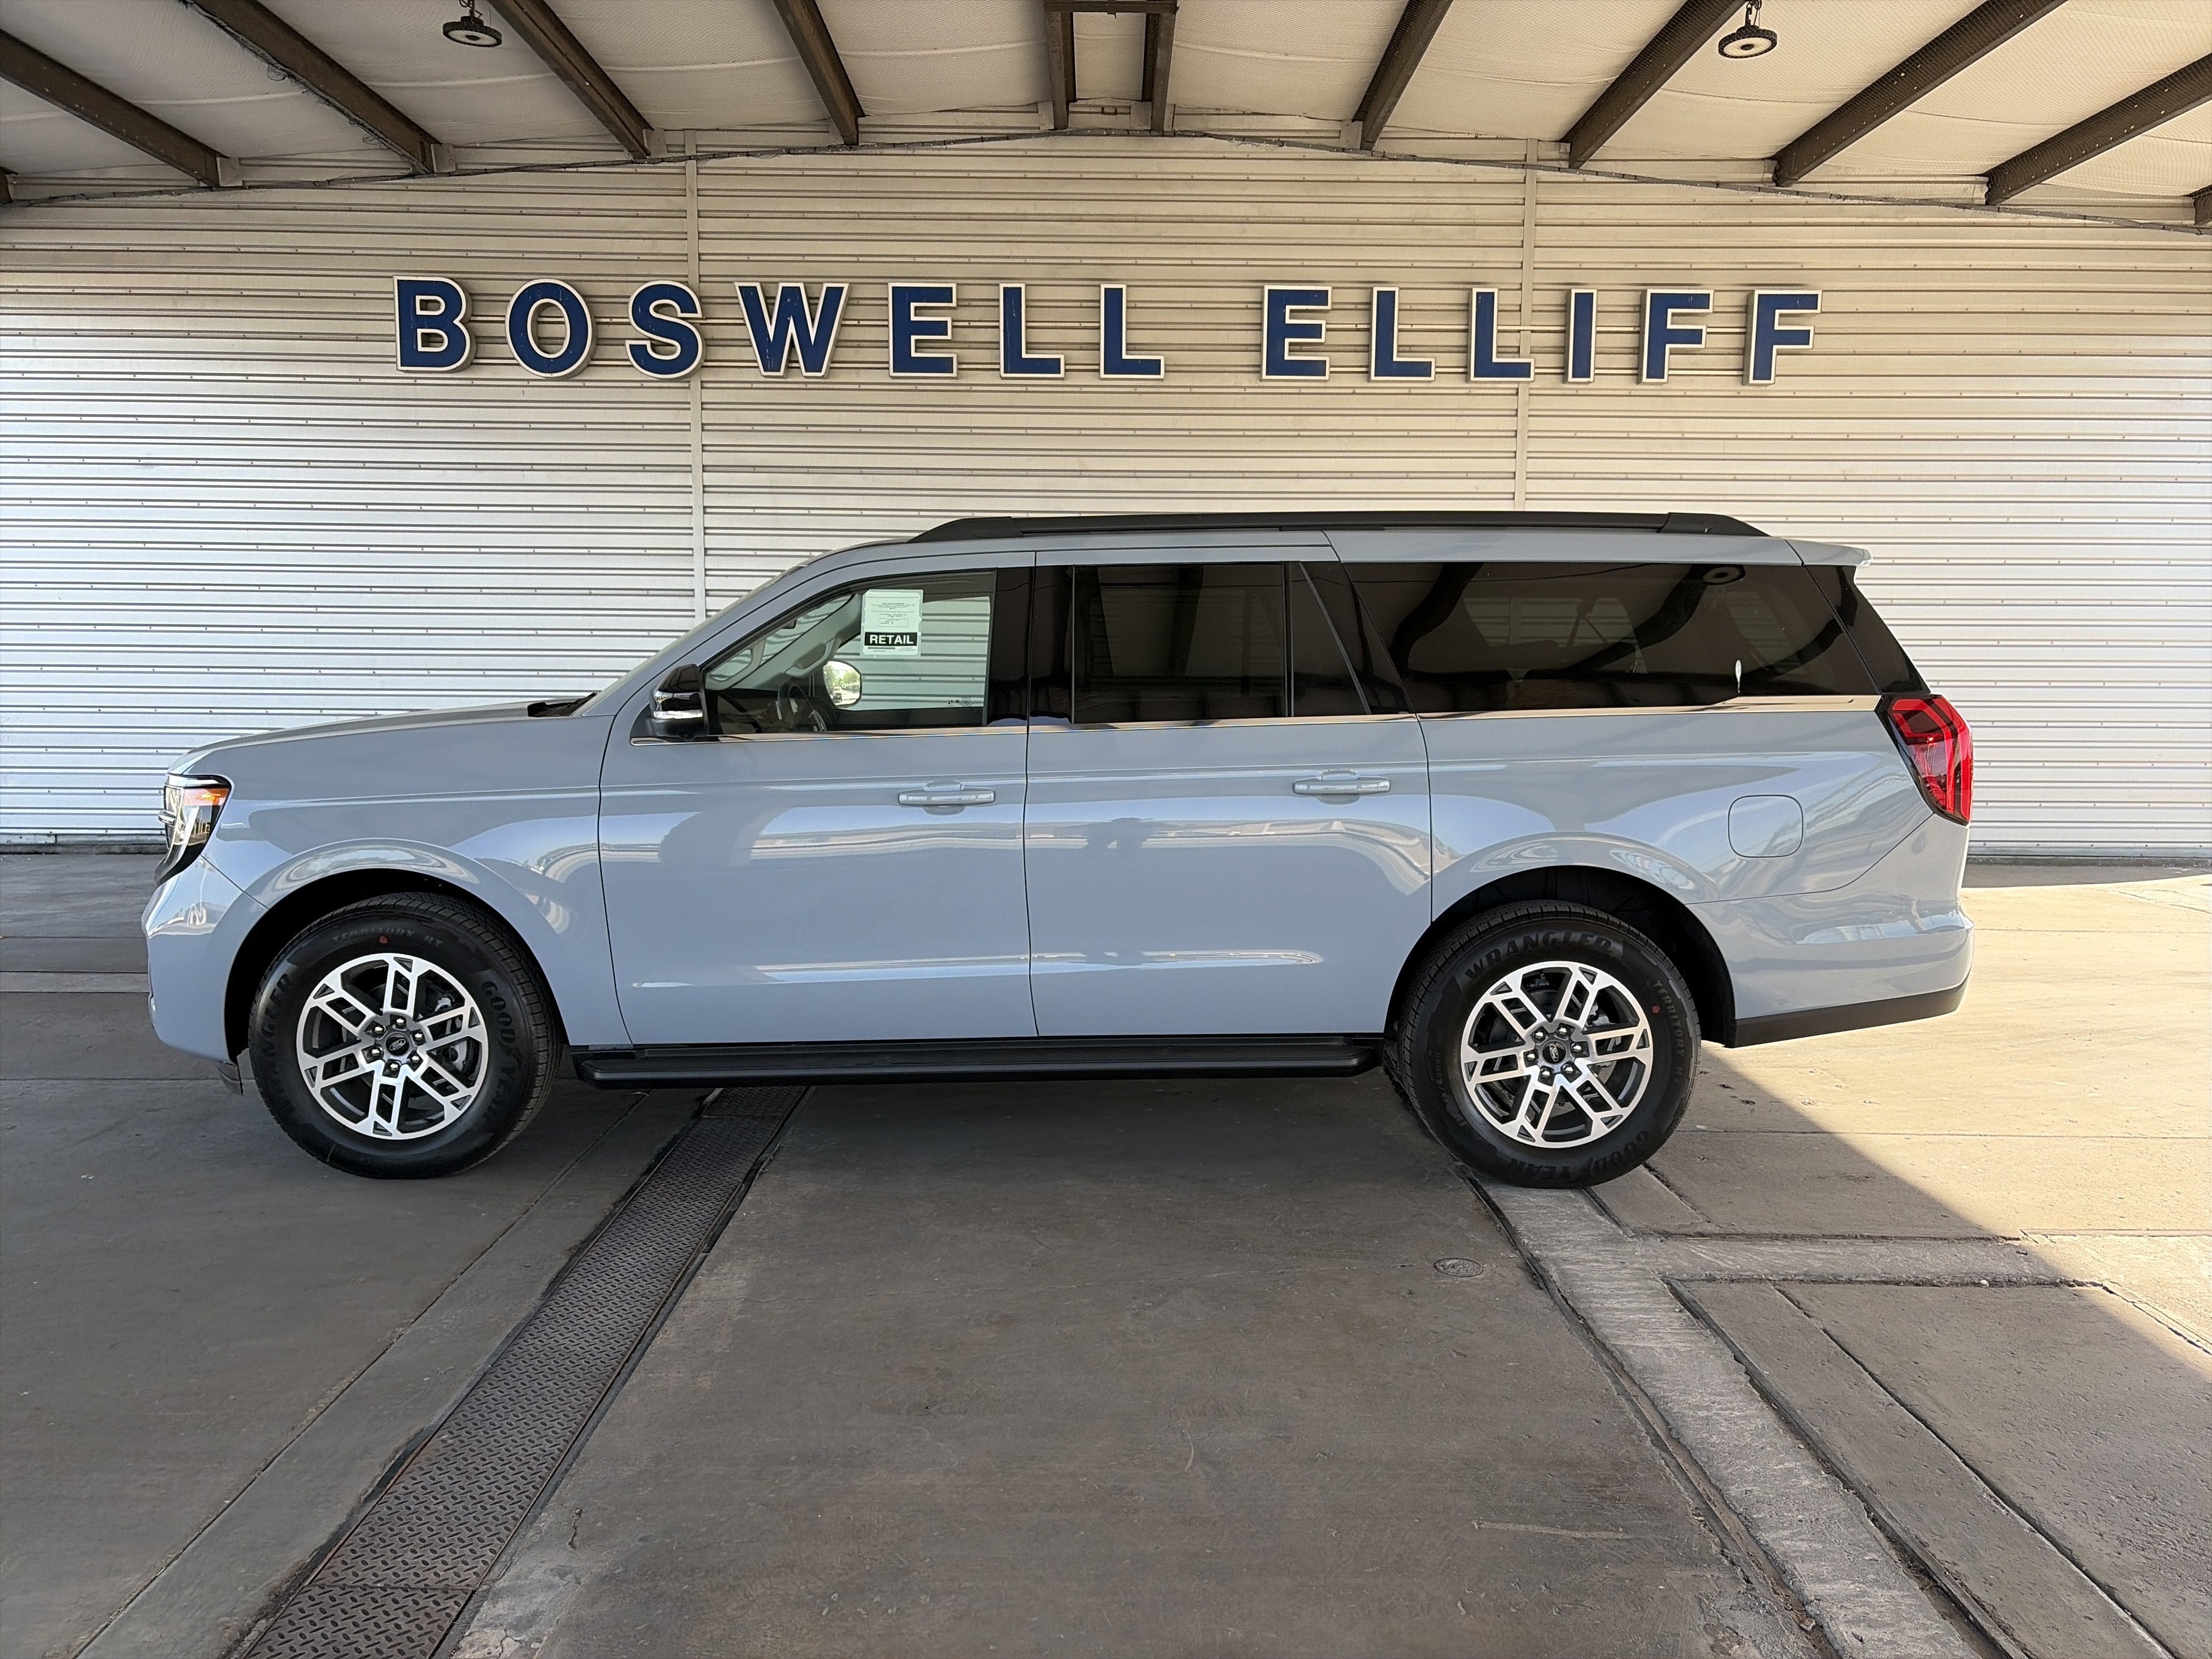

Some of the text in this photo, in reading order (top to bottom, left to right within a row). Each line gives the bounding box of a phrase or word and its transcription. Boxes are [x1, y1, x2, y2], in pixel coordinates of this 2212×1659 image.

[393, 275, 1822, 386] BOSWELL ELLIFF
[870, 634, 914, 645] RETAIL
[1464, 930, 1612, 980] WRANGLER
[1653, 980, 1685, 1057] TERRITORY
